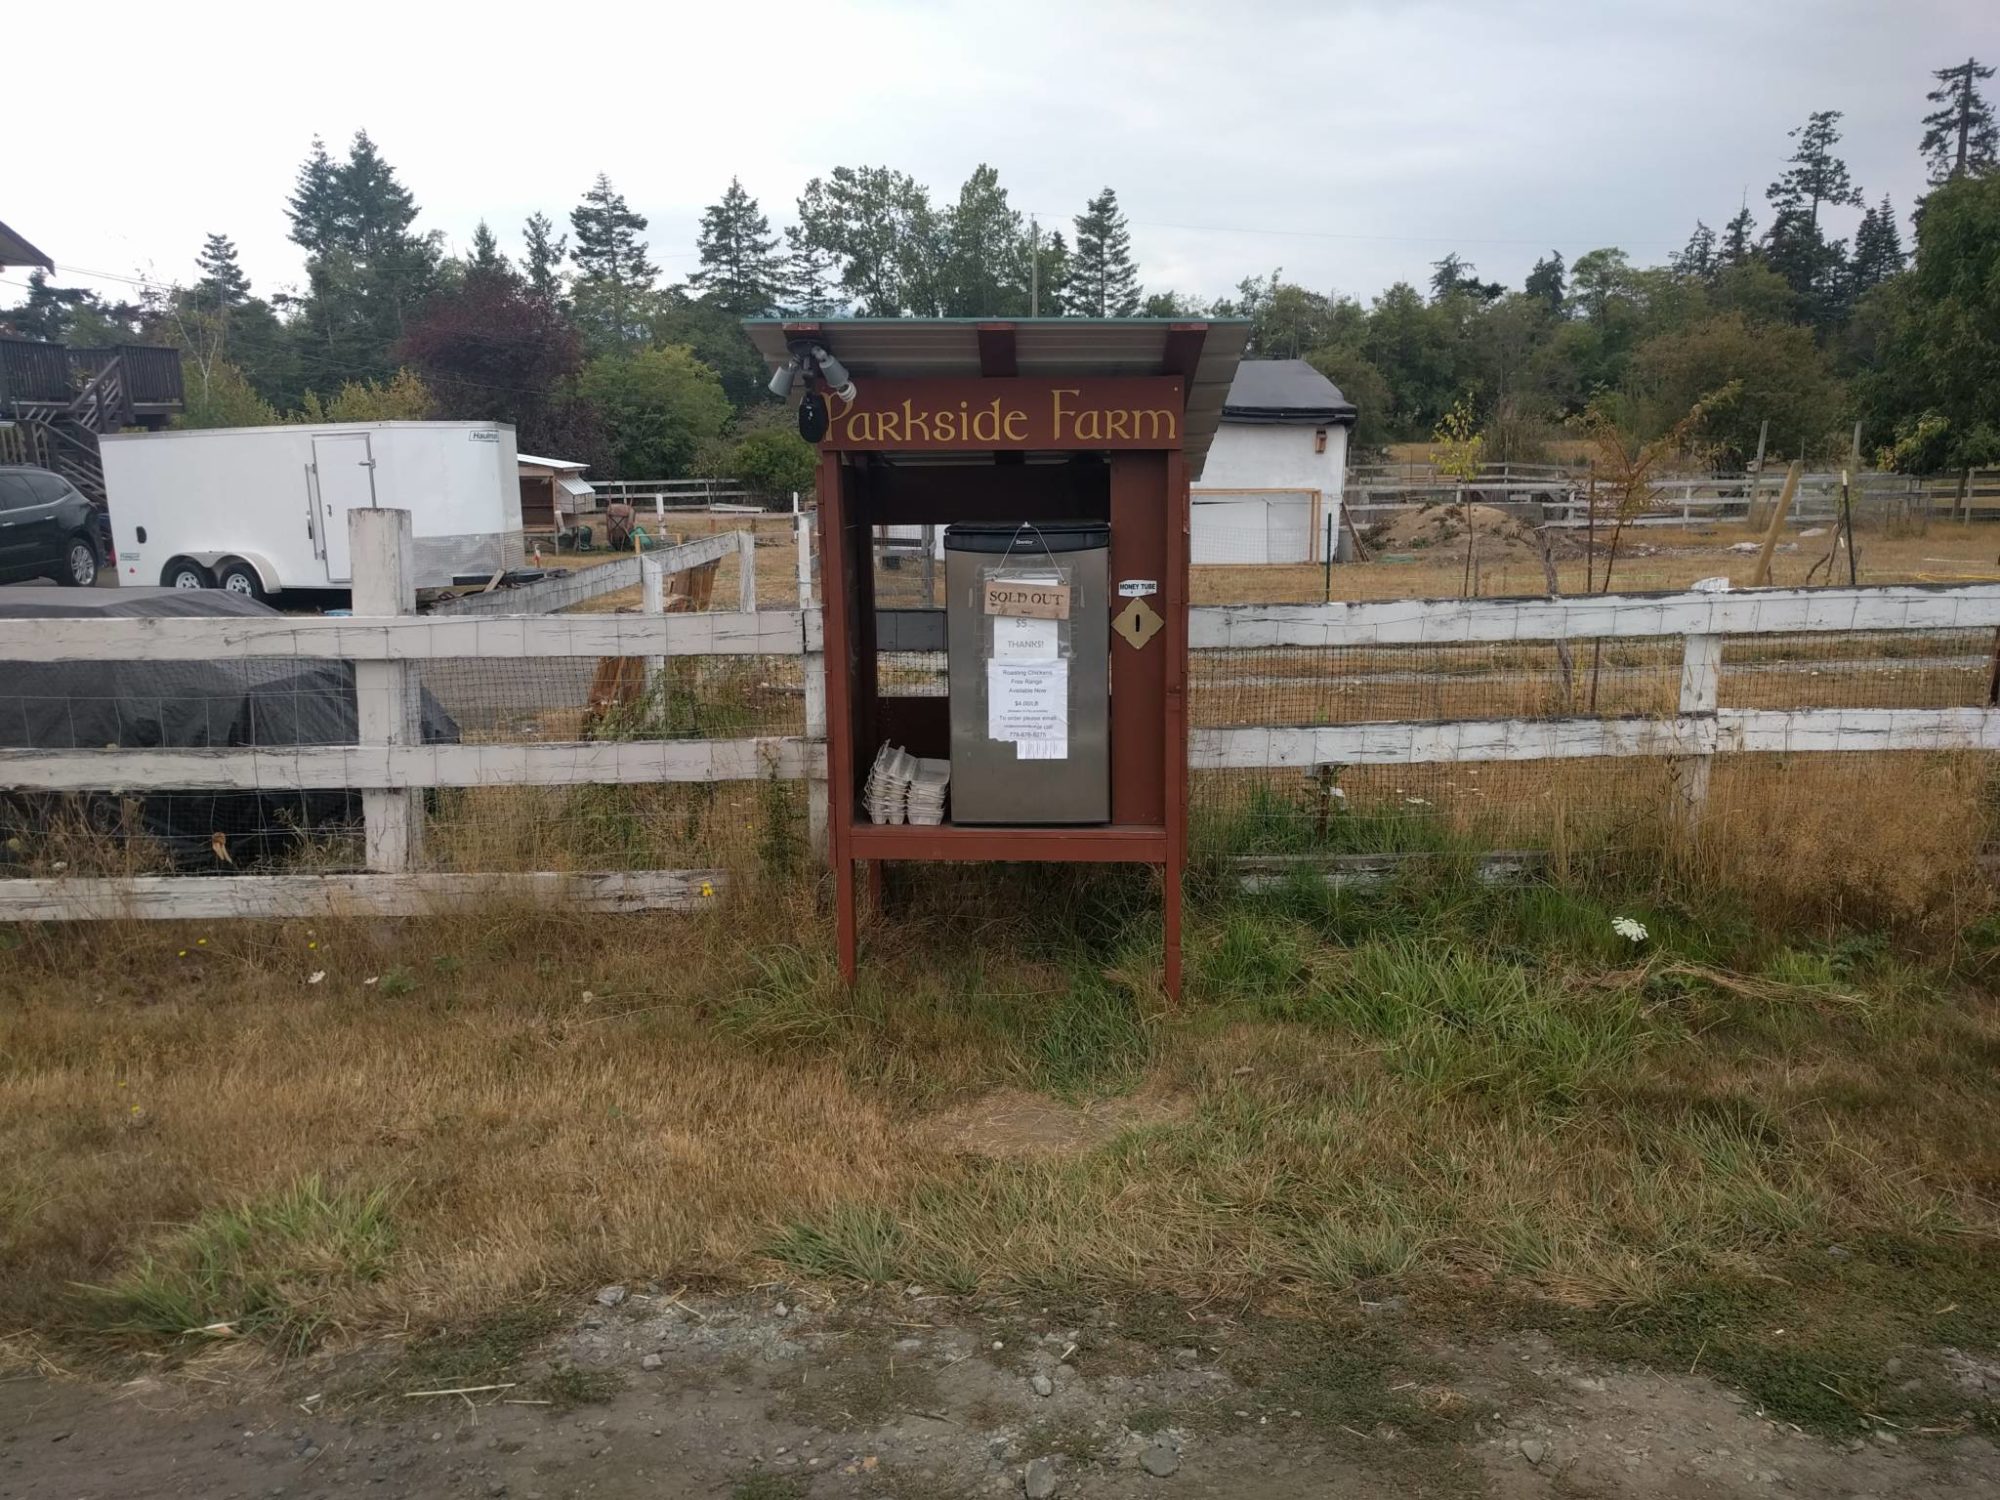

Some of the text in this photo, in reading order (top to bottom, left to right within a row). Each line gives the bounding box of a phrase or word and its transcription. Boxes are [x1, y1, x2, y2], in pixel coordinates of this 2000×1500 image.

[820, 389, 1176, 441] Parkside Farm
[1119, 583, 1156, 591] MONEY TUBE
[989, 590, 1065, 606] SOLD OUT
[1007, 640, 1045, 649] THANKS!
[1002, 669, 1027, 677] Roasting
